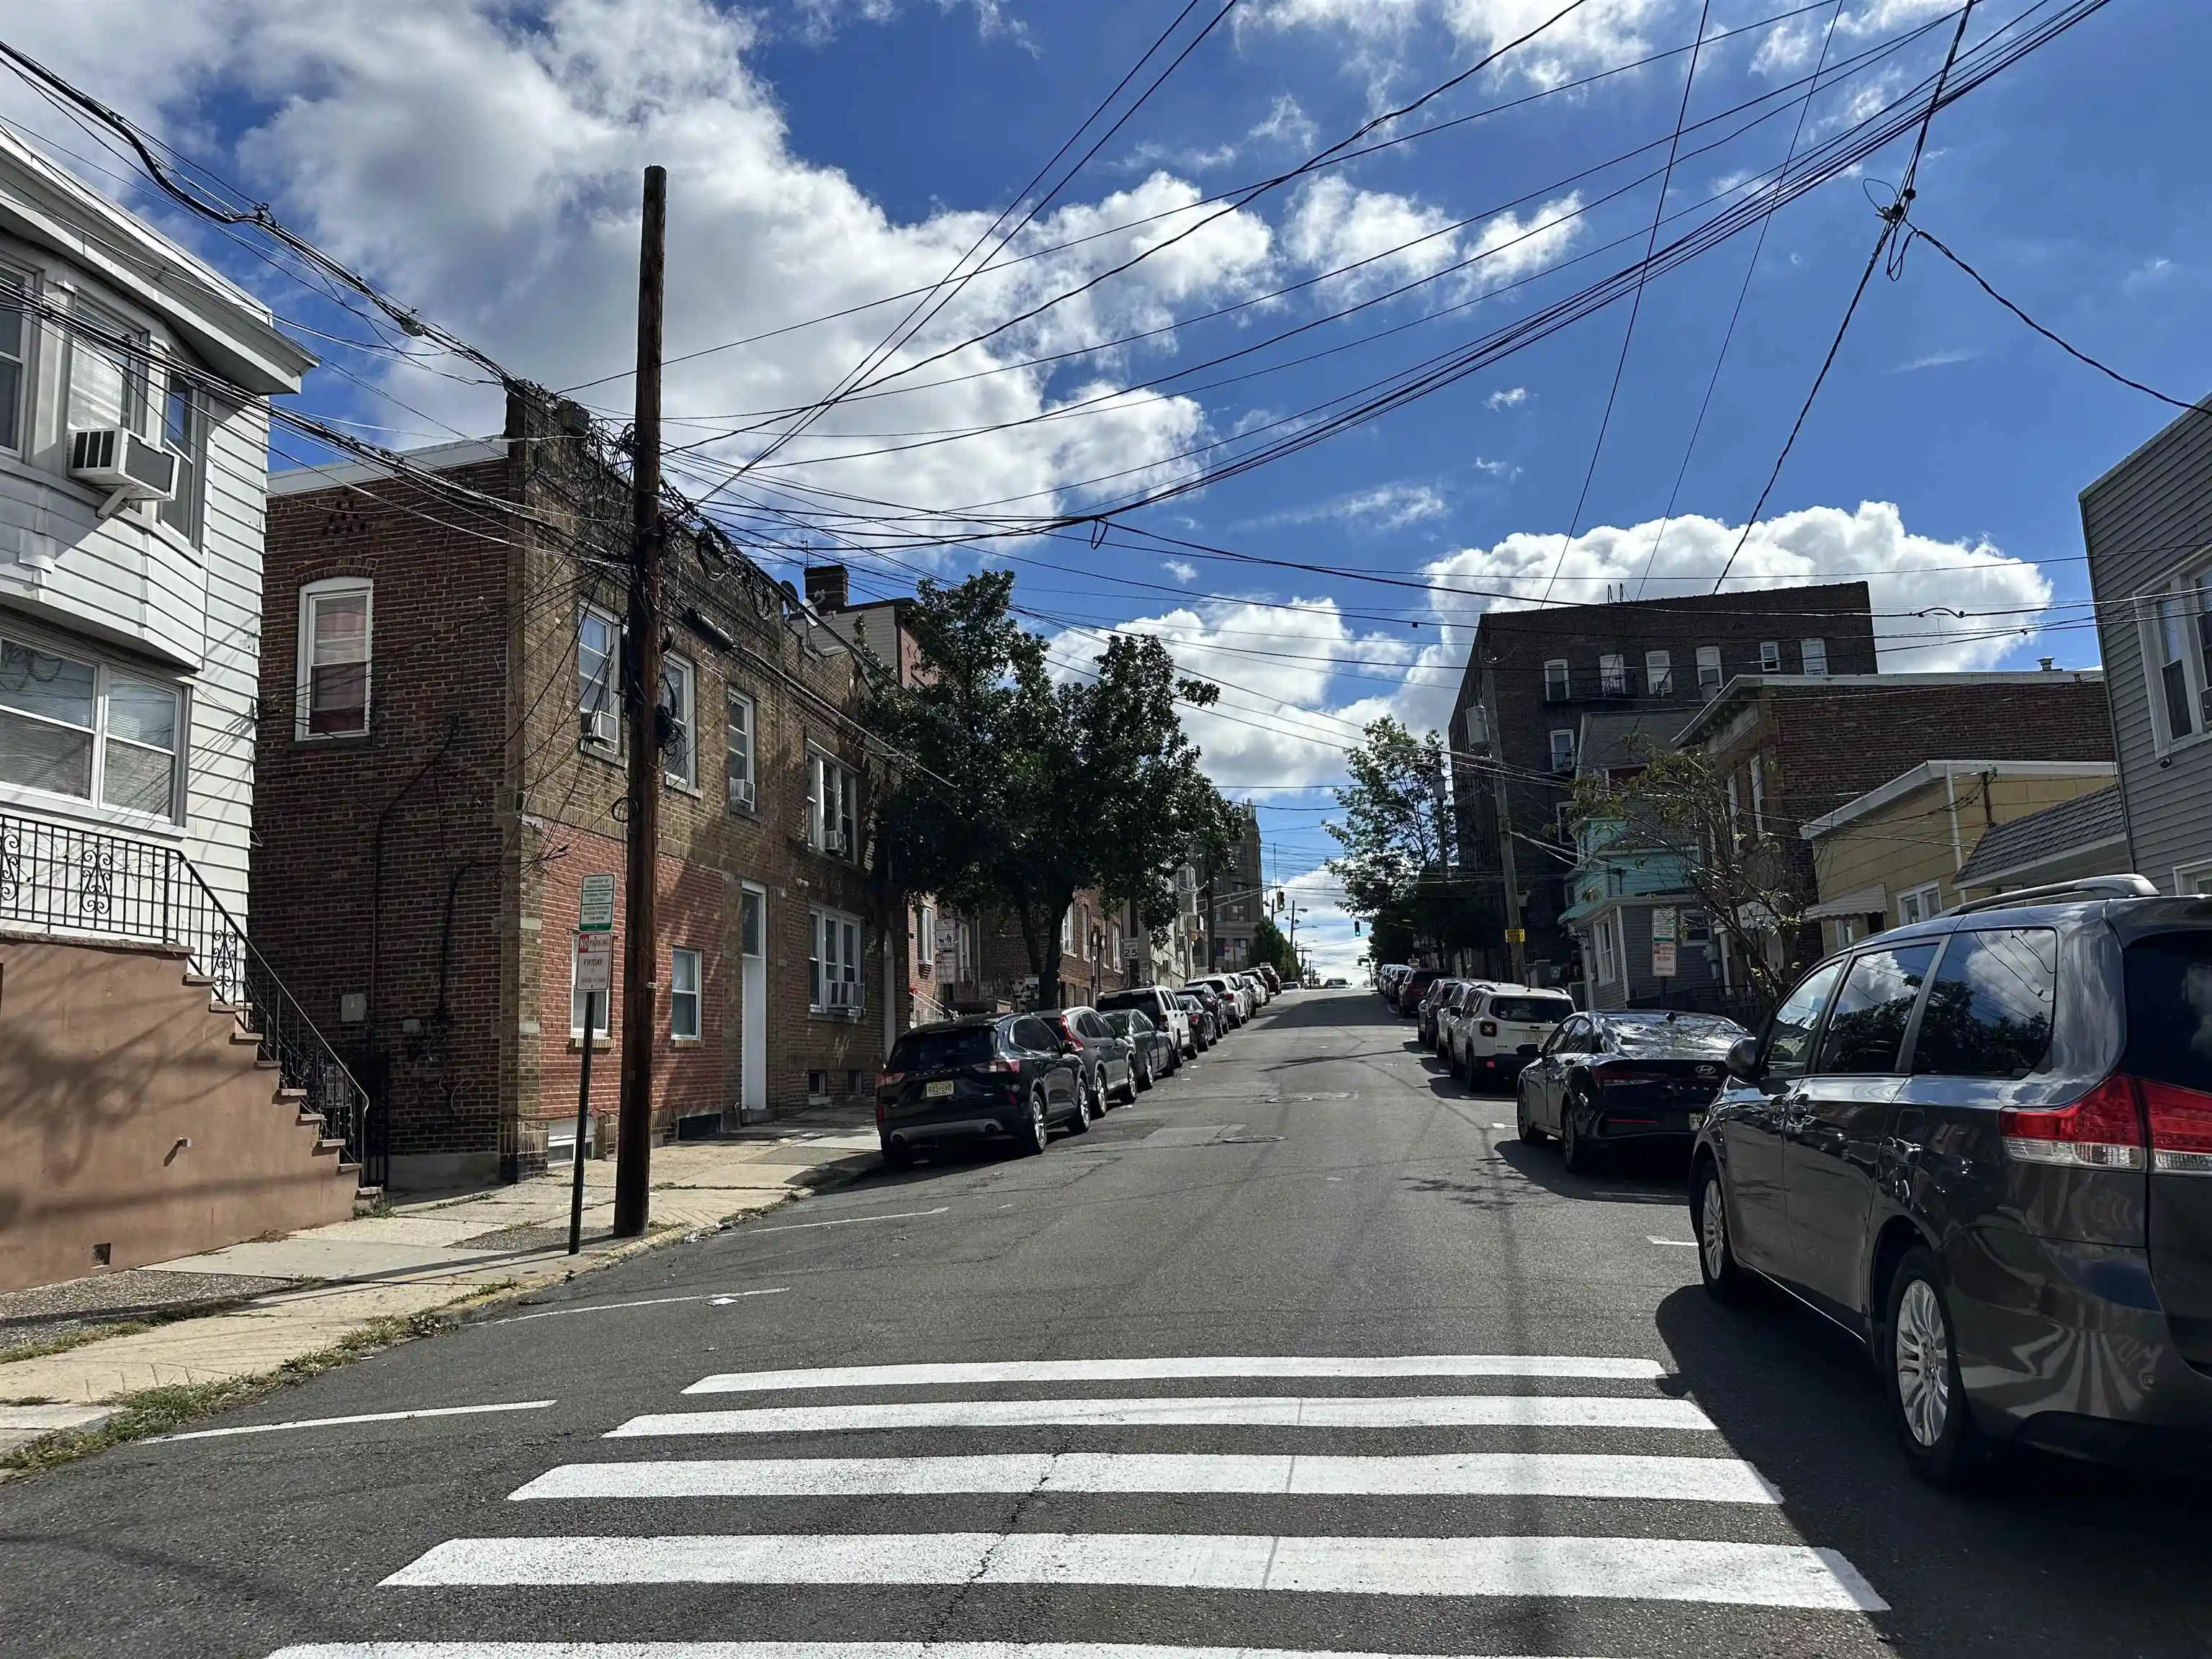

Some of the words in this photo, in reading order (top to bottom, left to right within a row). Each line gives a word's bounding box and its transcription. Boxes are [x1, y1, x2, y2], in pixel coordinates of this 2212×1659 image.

[579, 938, 588, 949] NO
[588, 938, 609, 947] PARKING
[583, 958, 603, 967] FRIDAY
